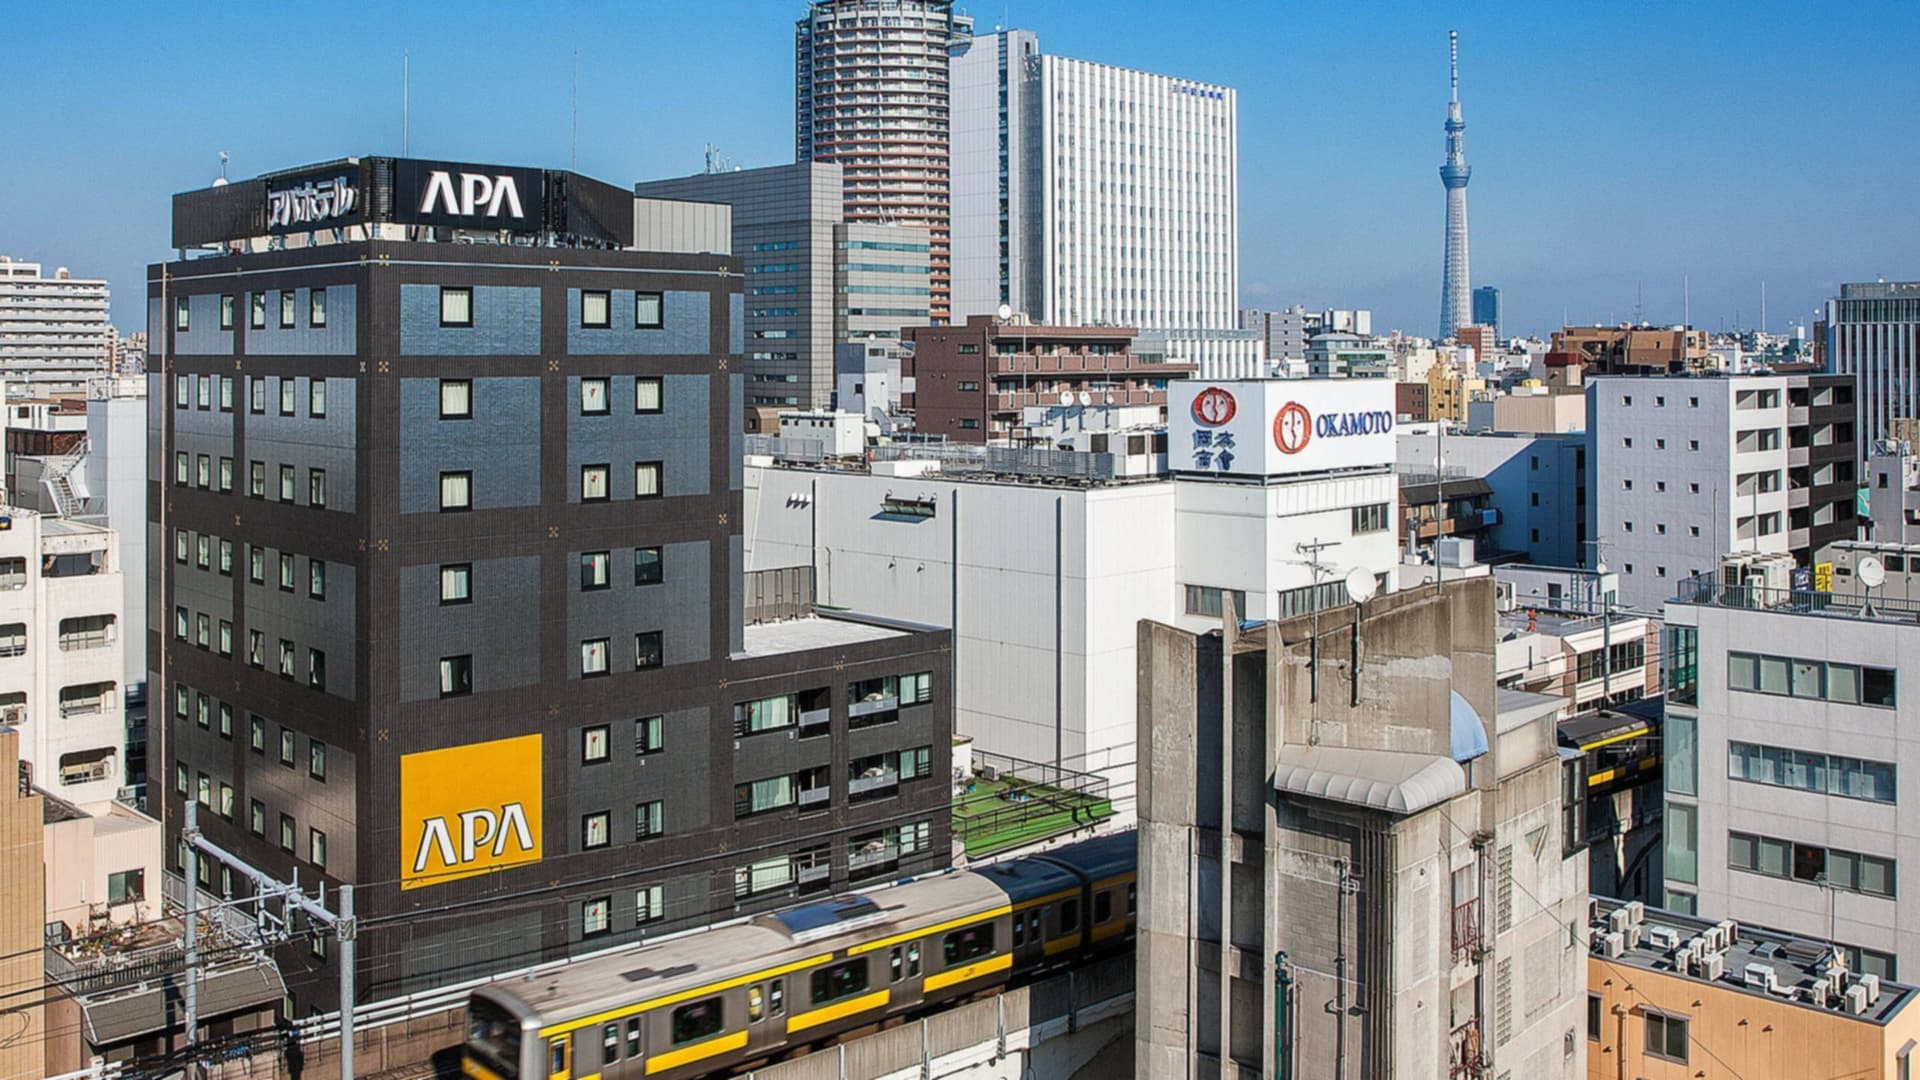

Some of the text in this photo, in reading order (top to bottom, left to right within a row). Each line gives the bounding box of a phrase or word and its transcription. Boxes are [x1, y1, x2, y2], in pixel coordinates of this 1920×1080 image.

[420, 171, 524, 218] APA
[1316, 410, 1393, 439] OKAMOTO
[413, 802, 534, 873] APA
